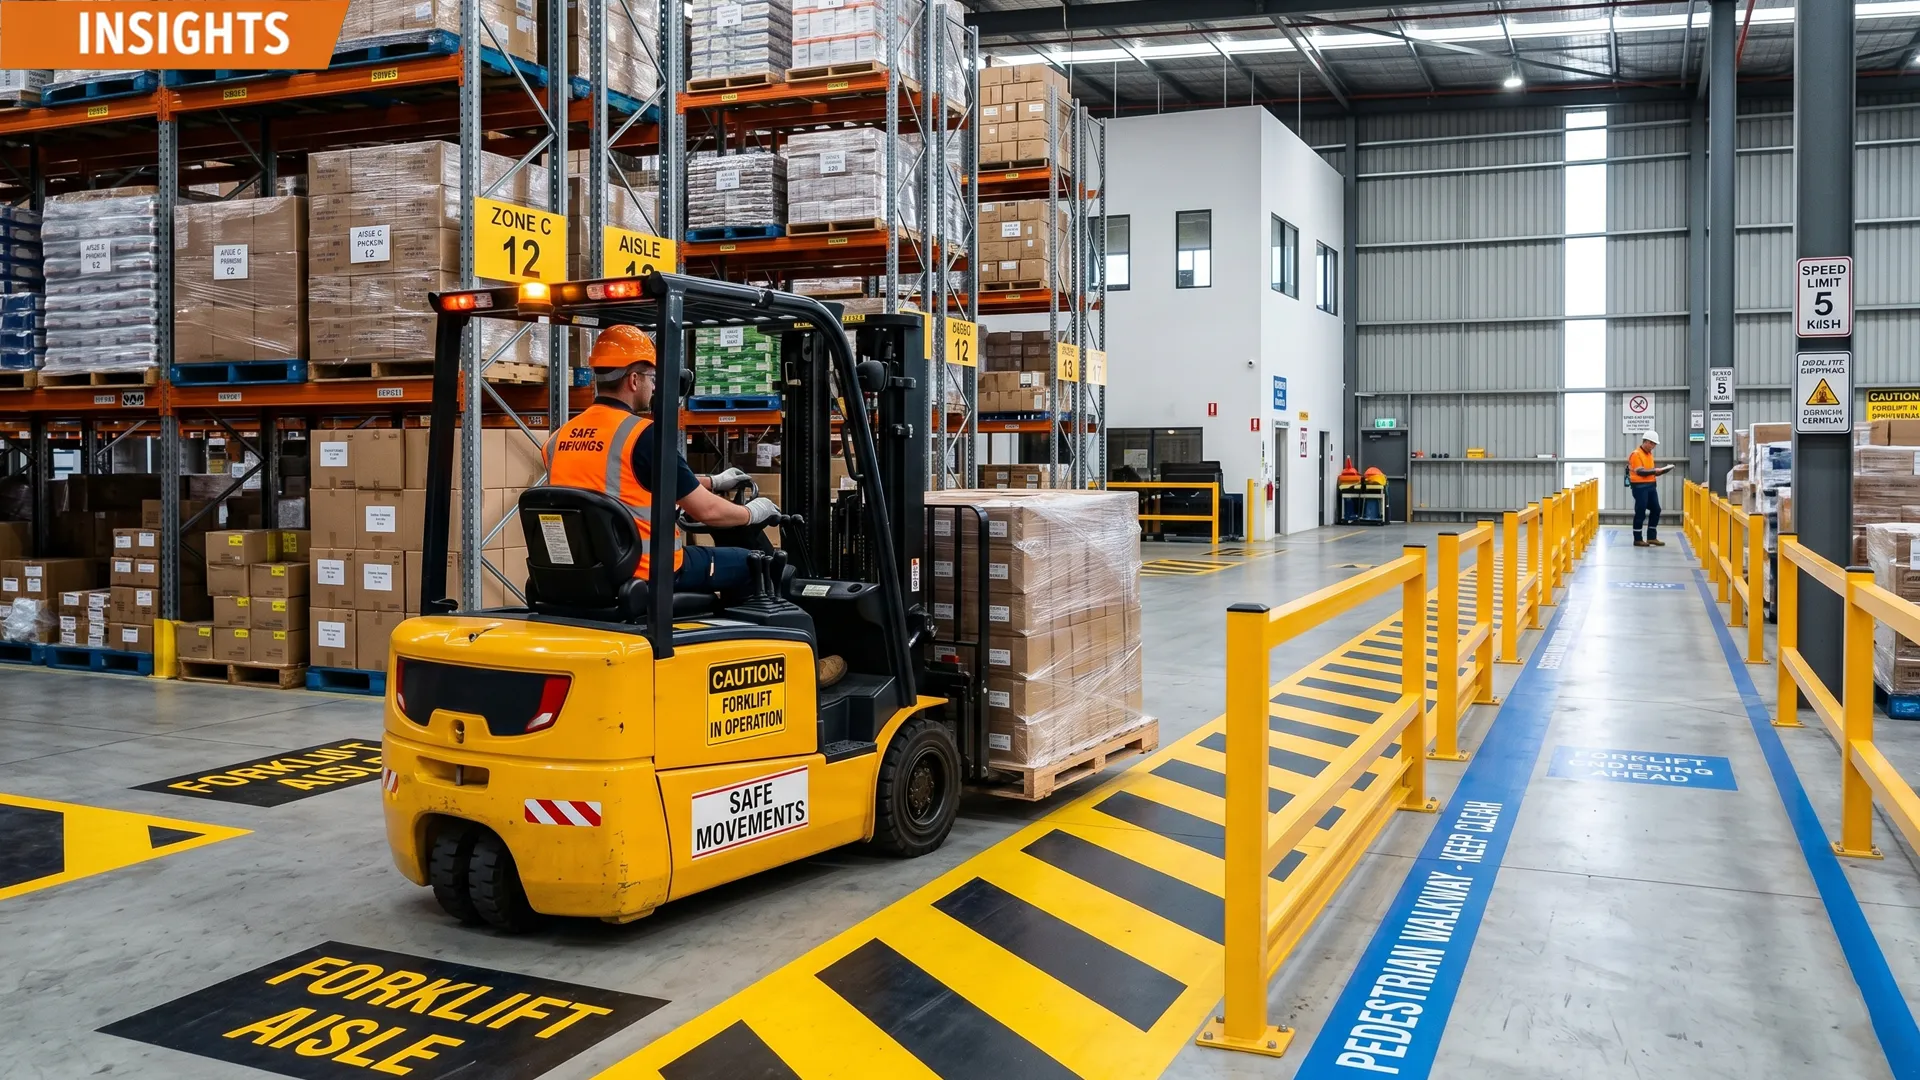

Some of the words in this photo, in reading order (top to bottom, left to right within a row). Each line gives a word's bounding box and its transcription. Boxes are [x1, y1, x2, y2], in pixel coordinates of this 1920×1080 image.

[491, 206, 536, 233] ZONE
[540, 217, 552, 236] C
[503, 235, 541, 279] 12
[619, 235, 661, 259] AISLE
[1802, 264, 1846, 276] SPEED
[1807, 277, 1842, 288] LIMIT
[1814, 291, 1834, 316] 5
[954, 338, 969, 362] 12
[1063, 359, 1073, 378] 13
[1717, 382, 1727, 394] 5
[569, 427, 598, 439] SAFE
[712, 662, 783, 690] CAUTION:
[722, 690, 773, 714] FORKLIFT
[710, 721, 722, 738] IN
[725, 709, 783, 736] OPERATION
[1574, 750, 1707, 767] FORKLIFT
[1589, 770, 1689, 783] AHEAD
[730, 782, 773, 815] SAFE
[696, 799, 805, 851] MOVEMENTS
[1335, 944, 1446, 1075] PEDESTRIAN
[1398, 870, 1474, 942] WALKWAY
[1439, 833, 1488, 863] KEEP
[265, 956, 614, 1039] FORKLIFT
[222, 1006, 466, 1076] AISLE
